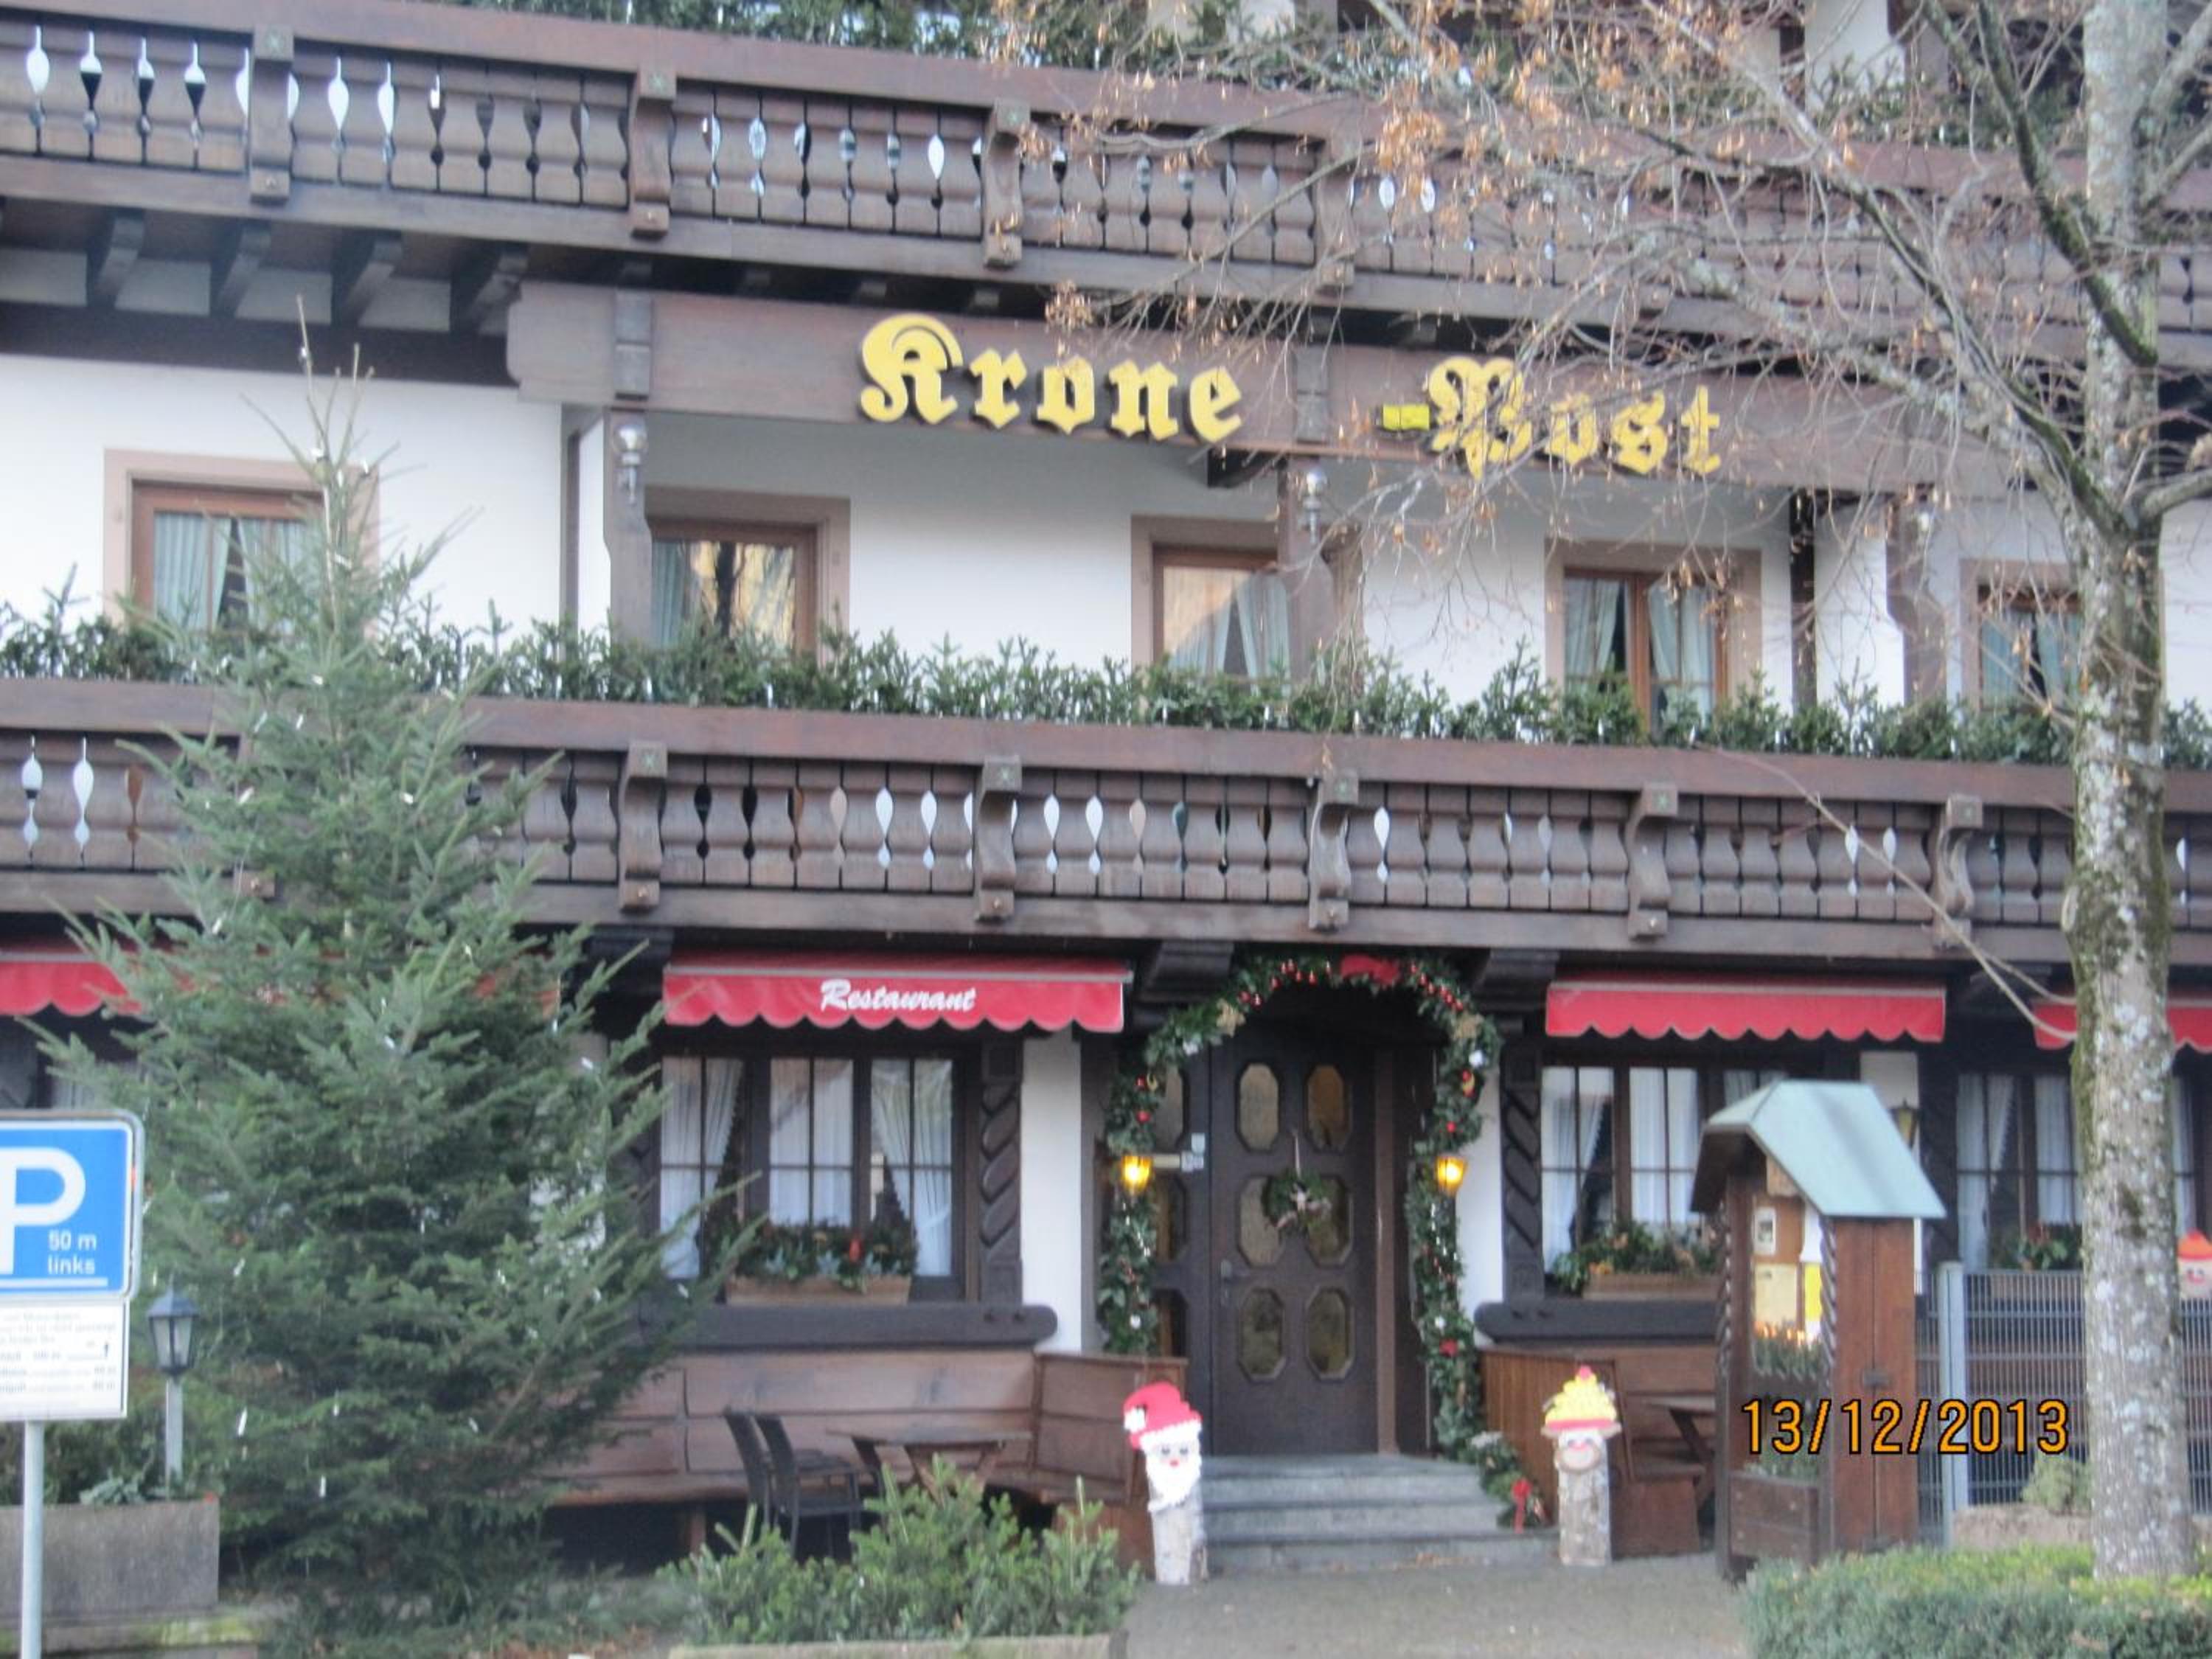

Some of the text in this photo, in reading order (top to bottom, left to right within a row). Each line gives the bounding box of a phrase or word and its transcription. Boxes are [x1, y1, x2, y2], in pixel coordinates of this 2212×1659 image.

[860, 313, 1243, 443] Krone
[820, 978, 978, 1012] Restaurant
[0, 1146, 86, 1275] P
[48, 1229, 97, 1251] 50 m
[47, 1254, 96, 1275] links
